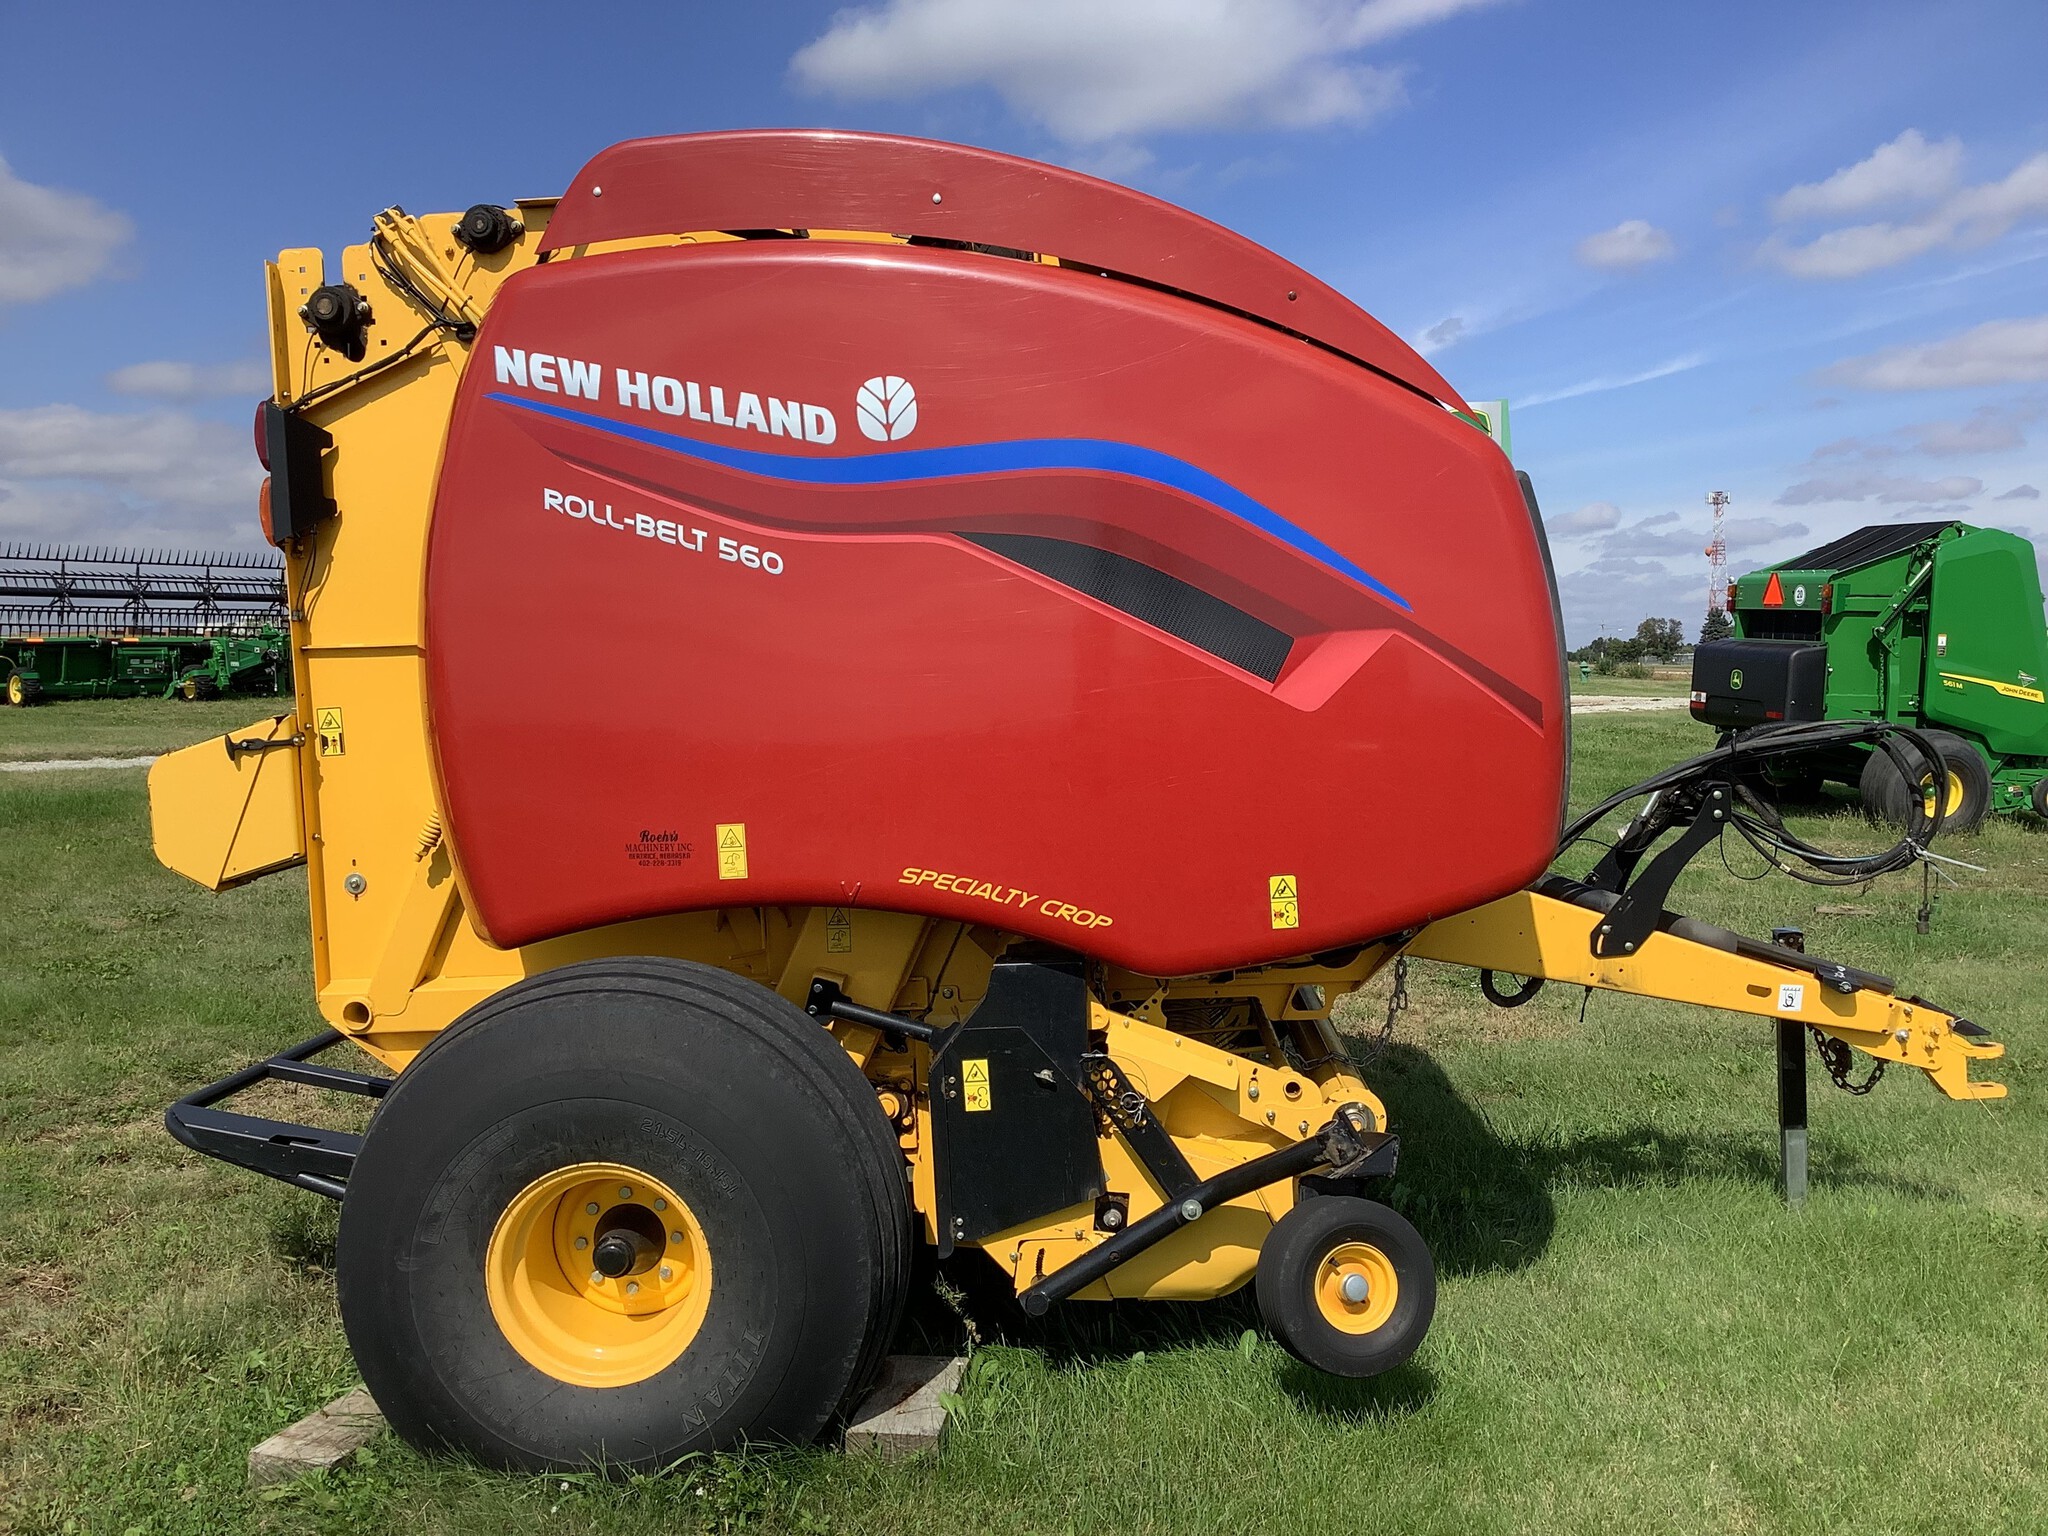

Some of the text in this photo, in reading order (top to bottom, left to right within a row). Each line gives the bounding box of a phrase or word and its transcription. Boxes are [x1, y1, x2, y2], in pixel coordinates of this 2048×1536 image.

[493, 344, 837, 445] NEW HOLLAND
[543, 487, 785, 576] ROLL-BELT 560
[625, 843, 695, 852] MACHINERY INC.
[898, 866, 1114, 929] SPECIALTY CROP
[680, 1324, 767, 1436] TITAN
